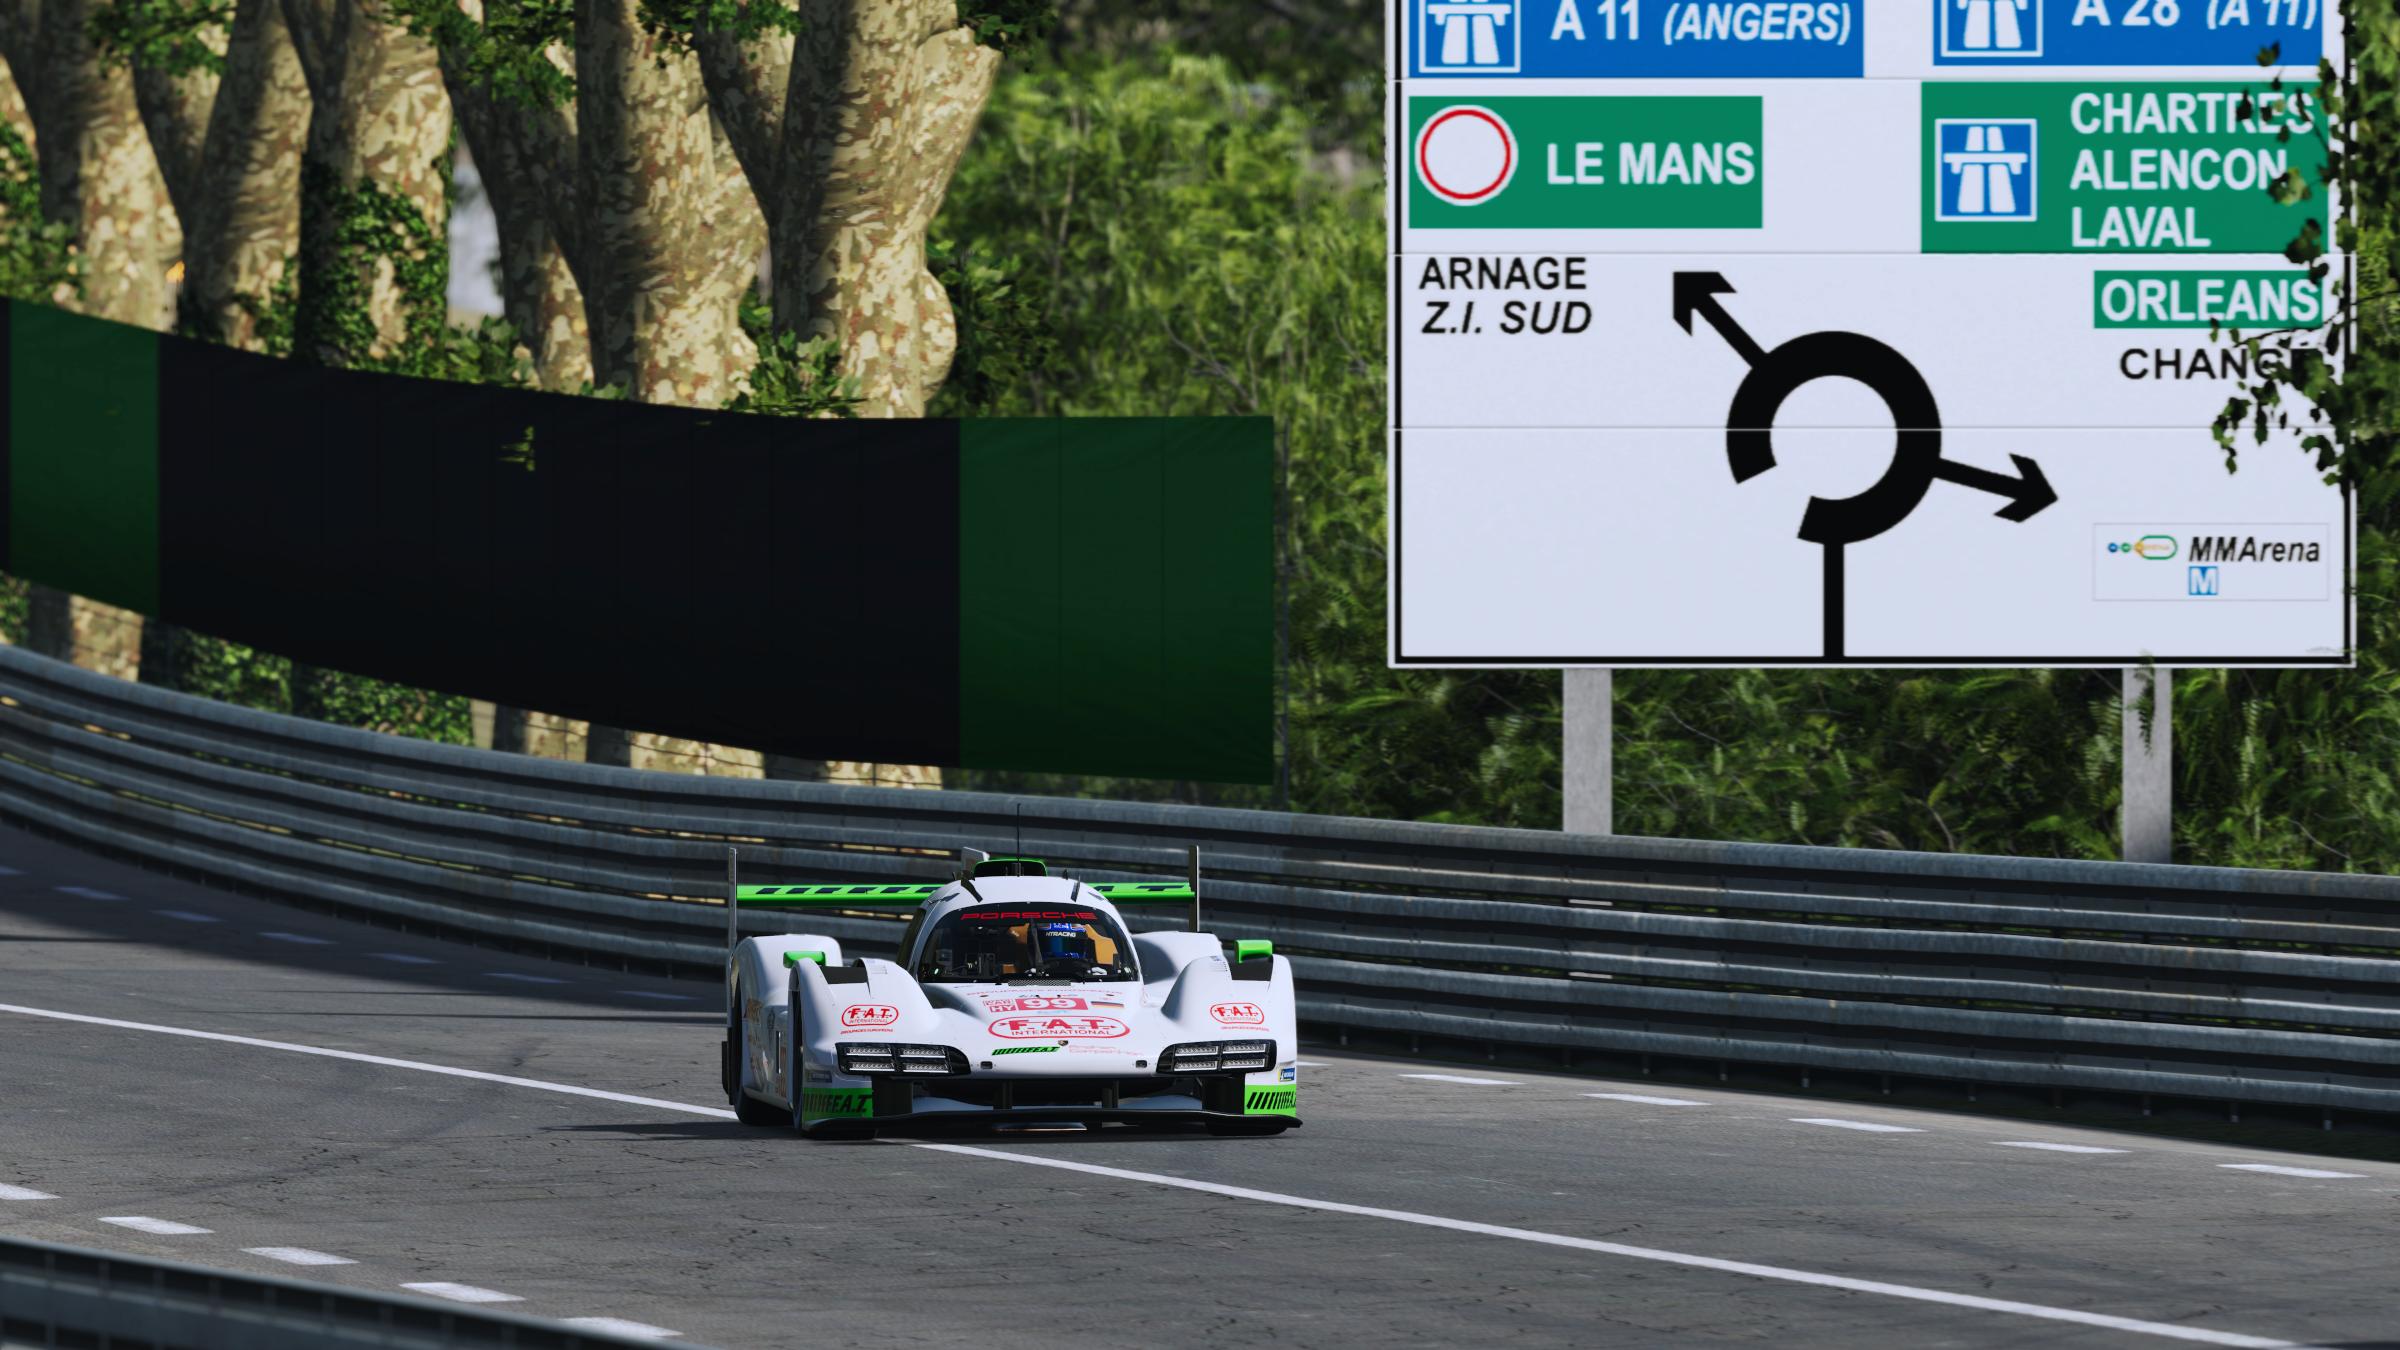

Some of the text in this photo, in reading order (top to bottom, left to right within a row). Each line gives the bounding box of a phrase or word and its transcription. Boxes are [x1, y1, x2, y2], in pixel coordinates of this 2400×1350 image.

[1550, 0, 1851, 45] A 11 (ANGERS)
[2071, 0, 2111, 27] A
[2070, 92, 2315, 135] CHARTRES
[1547, 142, 1755, 186] LE MANS
[2070, 148, 2287, 191] ALENCON
[2071, 206, 2211, 248] LAVAL
[1419, 257, 1587, 290] ARNAGE
[1422, 301, 1593, 335] Z.I. SUD
[2101, 278, 2320, 322] ORLEANS
[2188, 536, 2321, 563] MMArena
[960, 911, 1098, 921] PORSCHE
[1023, 998, 1078, 1010] 99
